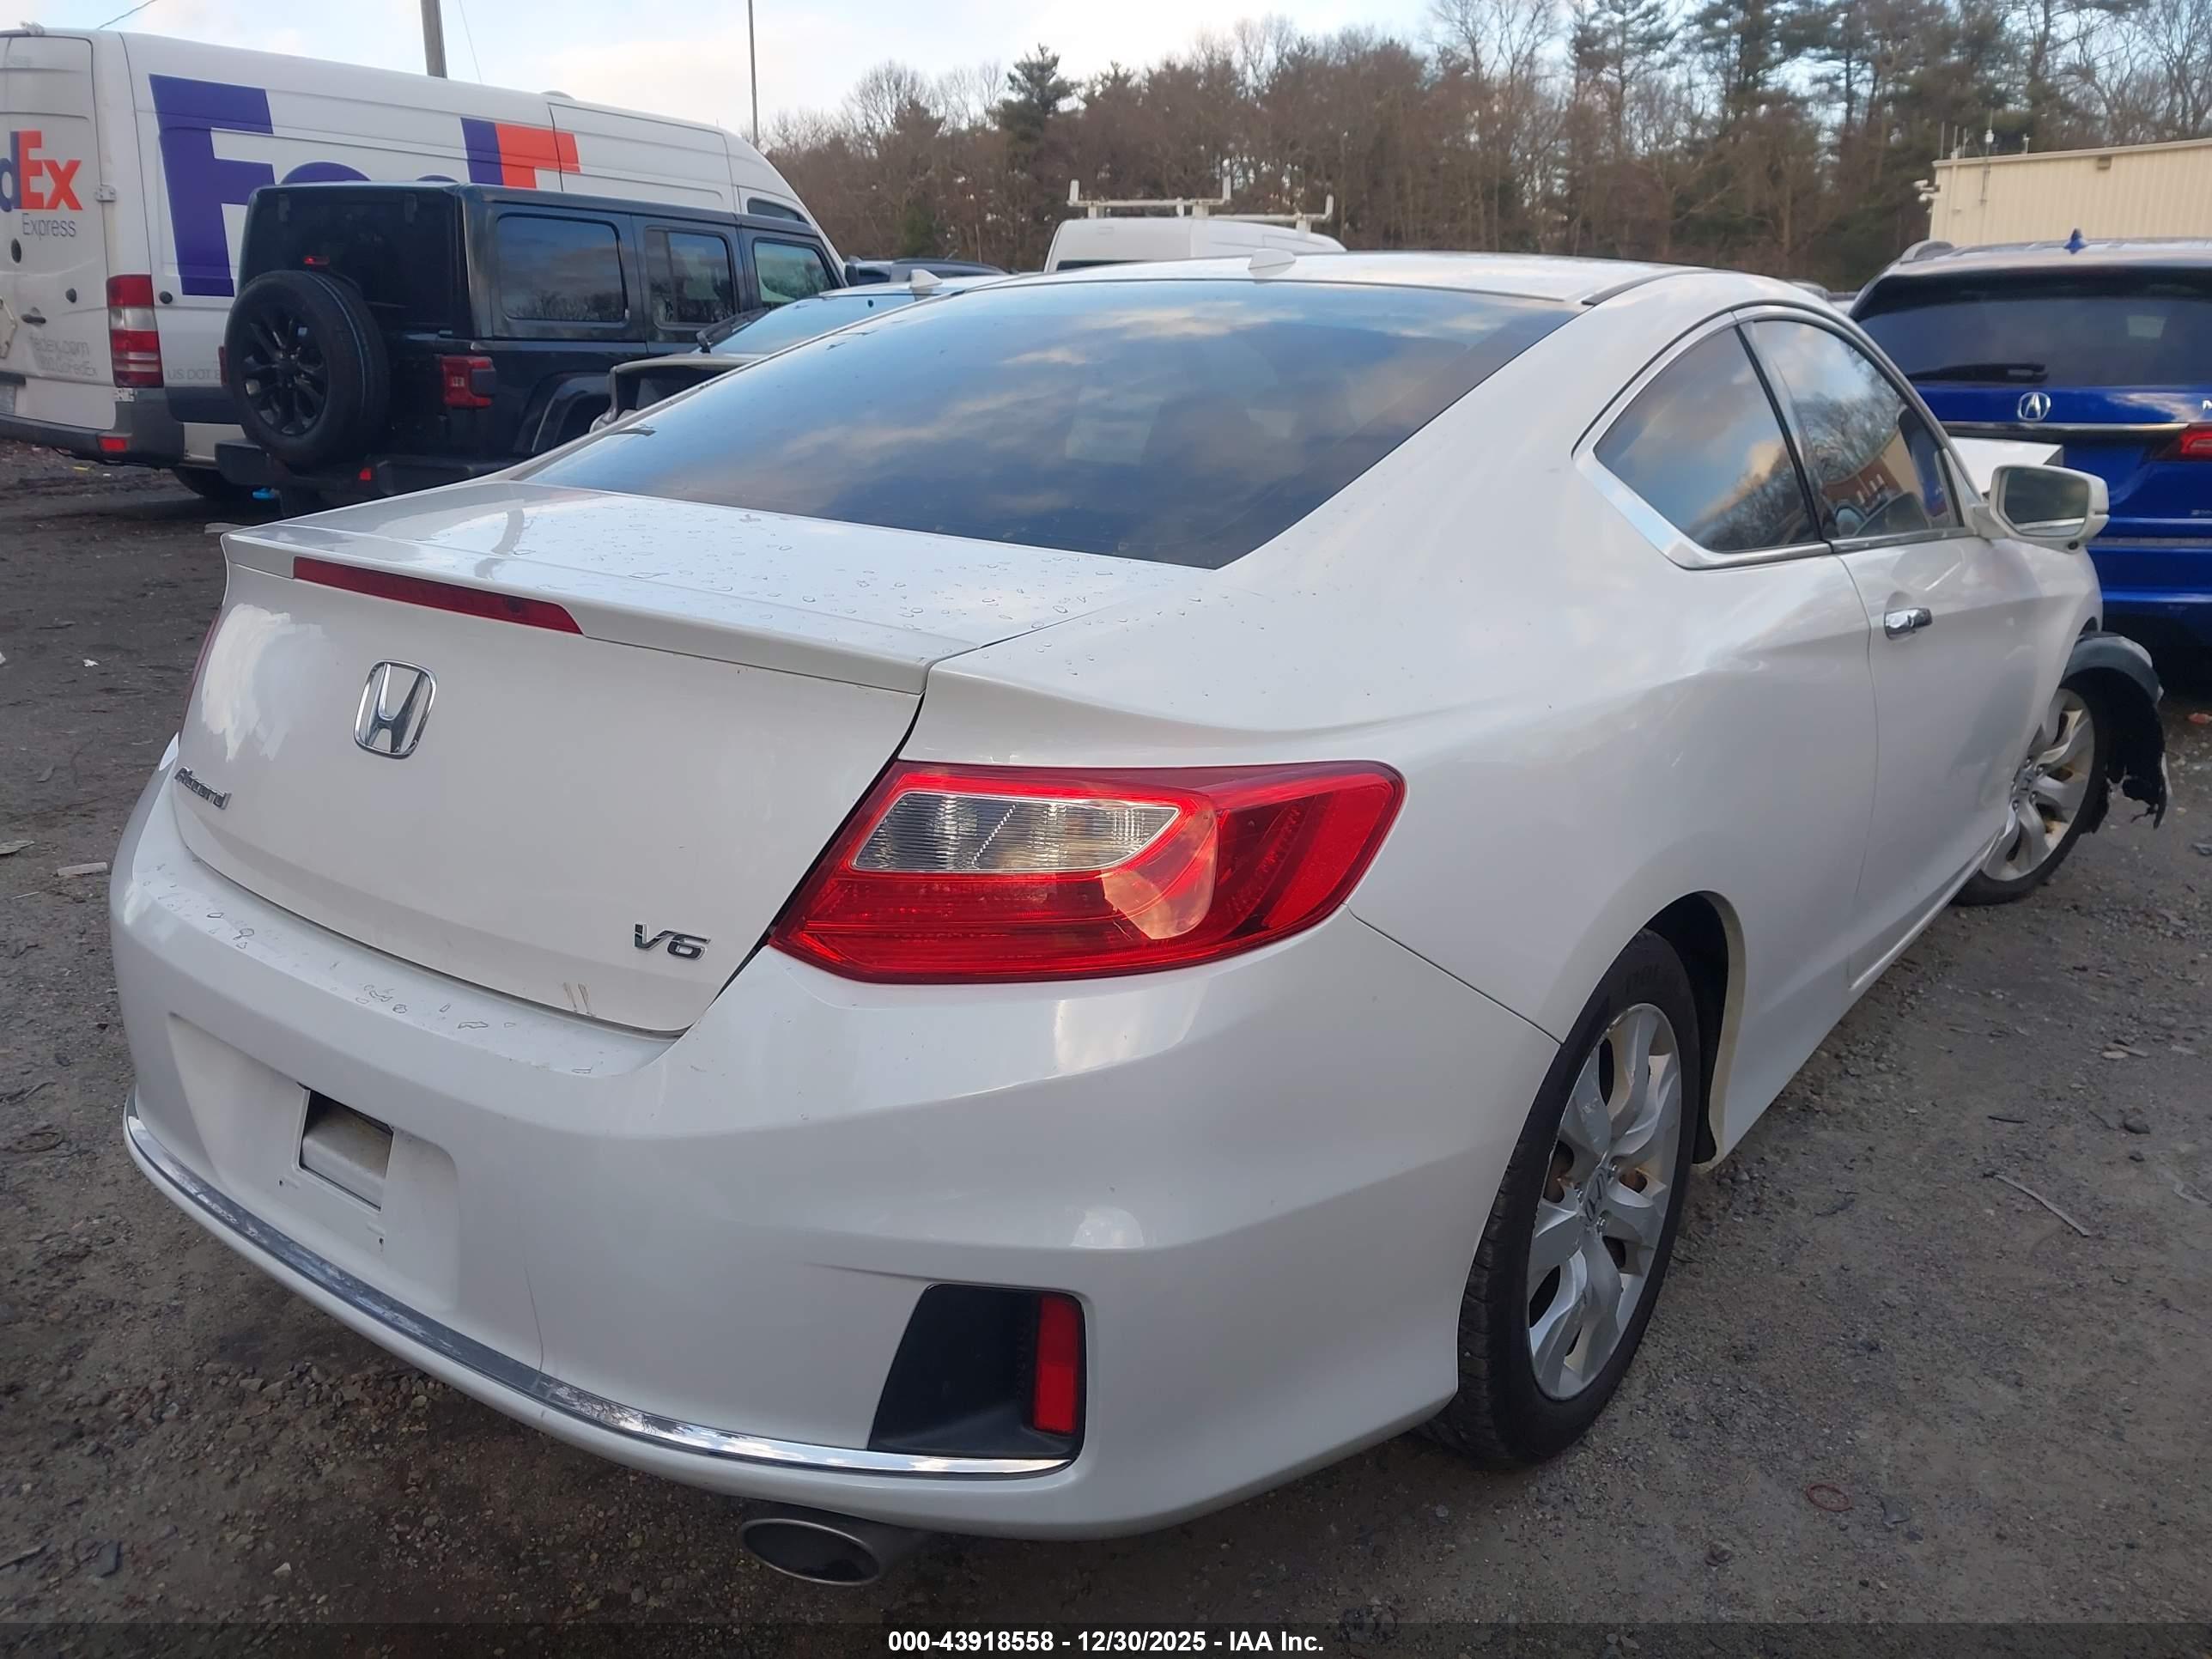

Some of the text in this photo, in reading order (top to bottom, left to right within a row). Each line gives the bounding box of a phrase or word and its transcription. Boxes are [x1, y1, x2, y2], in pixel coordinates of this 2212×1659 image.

[21, 212, 76, 240] Express
[174, 767, 232, 810] Accord
[635, 923, 710, 961] V6
